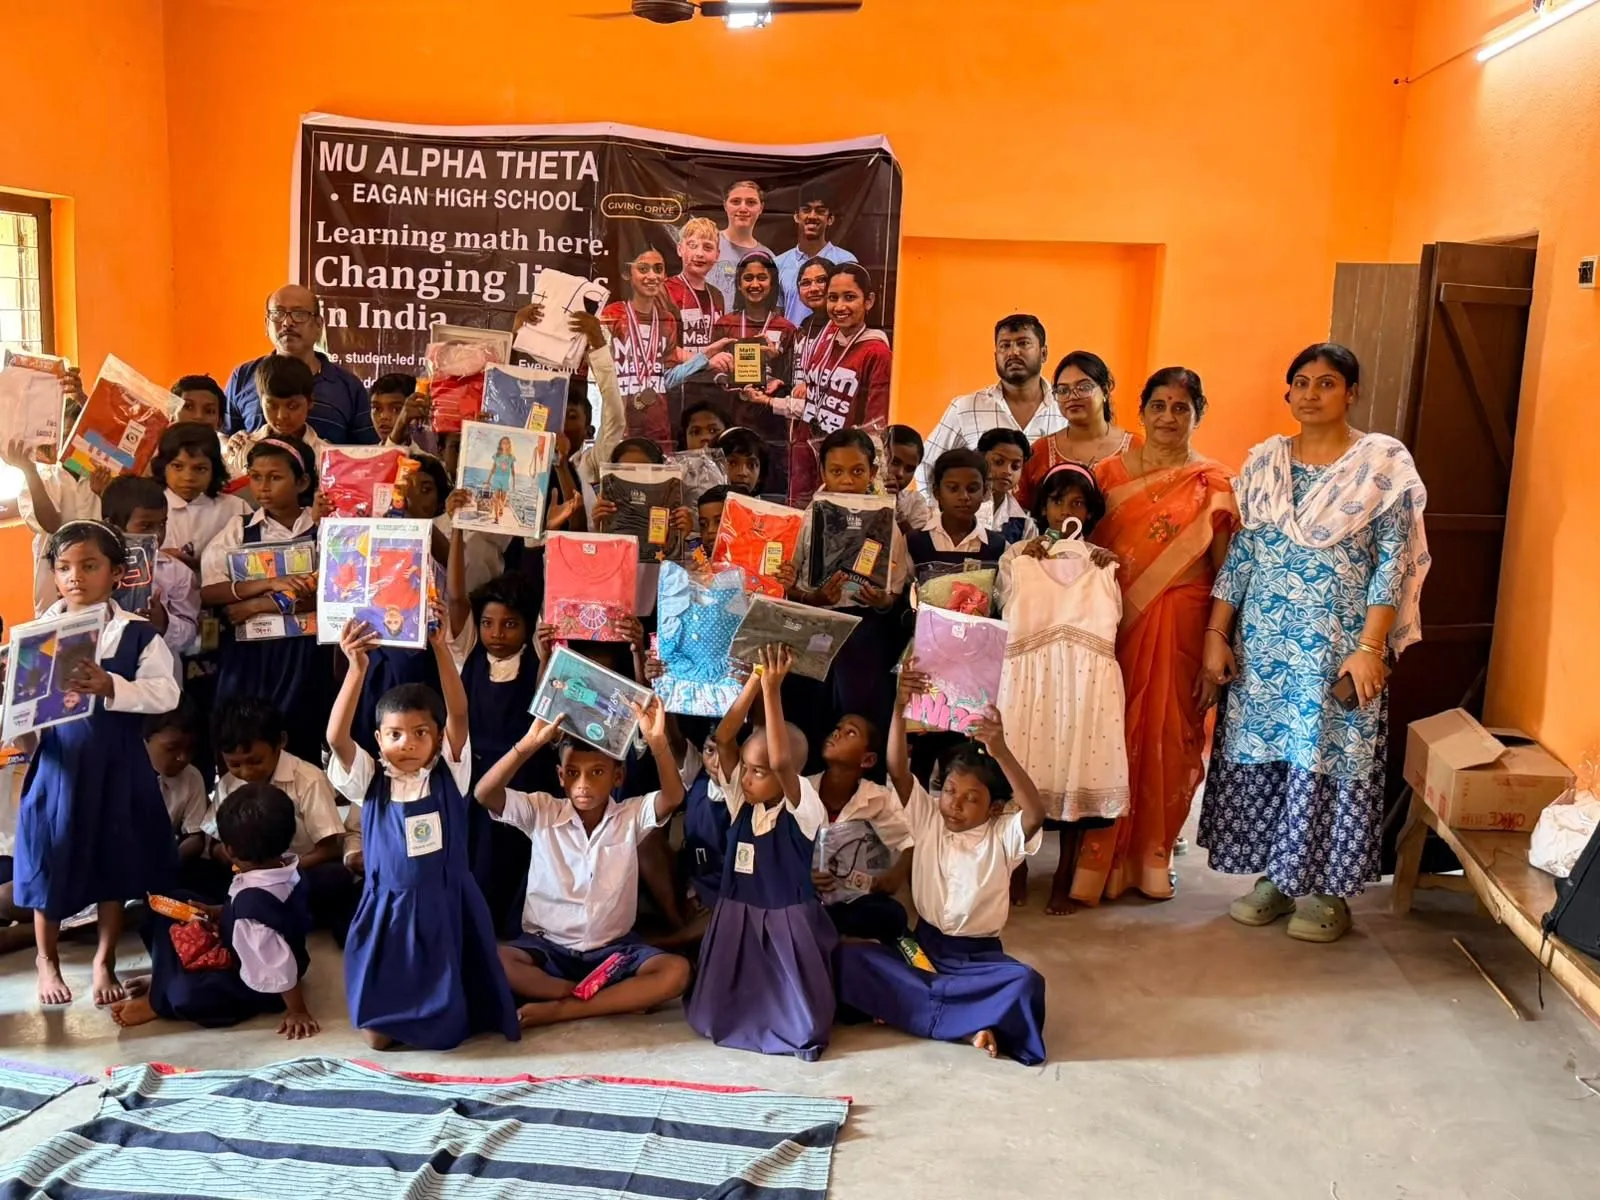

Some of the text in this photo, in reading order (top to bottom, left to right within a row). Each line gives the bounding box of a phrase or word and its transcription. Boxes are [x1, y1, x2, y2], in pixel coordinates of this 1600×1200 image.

[319, 141, 600, 182] MU ALPHA THETA
[352, 183, 584, 212] EAGAN HIGH SCHOOL
[607, 201, 675, 214] GIVING DRIVE
[316, 221, 609, 256] Learning math here.
[314, 256, 507, 302] Changing
[318, 300, 448, 331] in India
[345, 352, 415, 366] student-led
